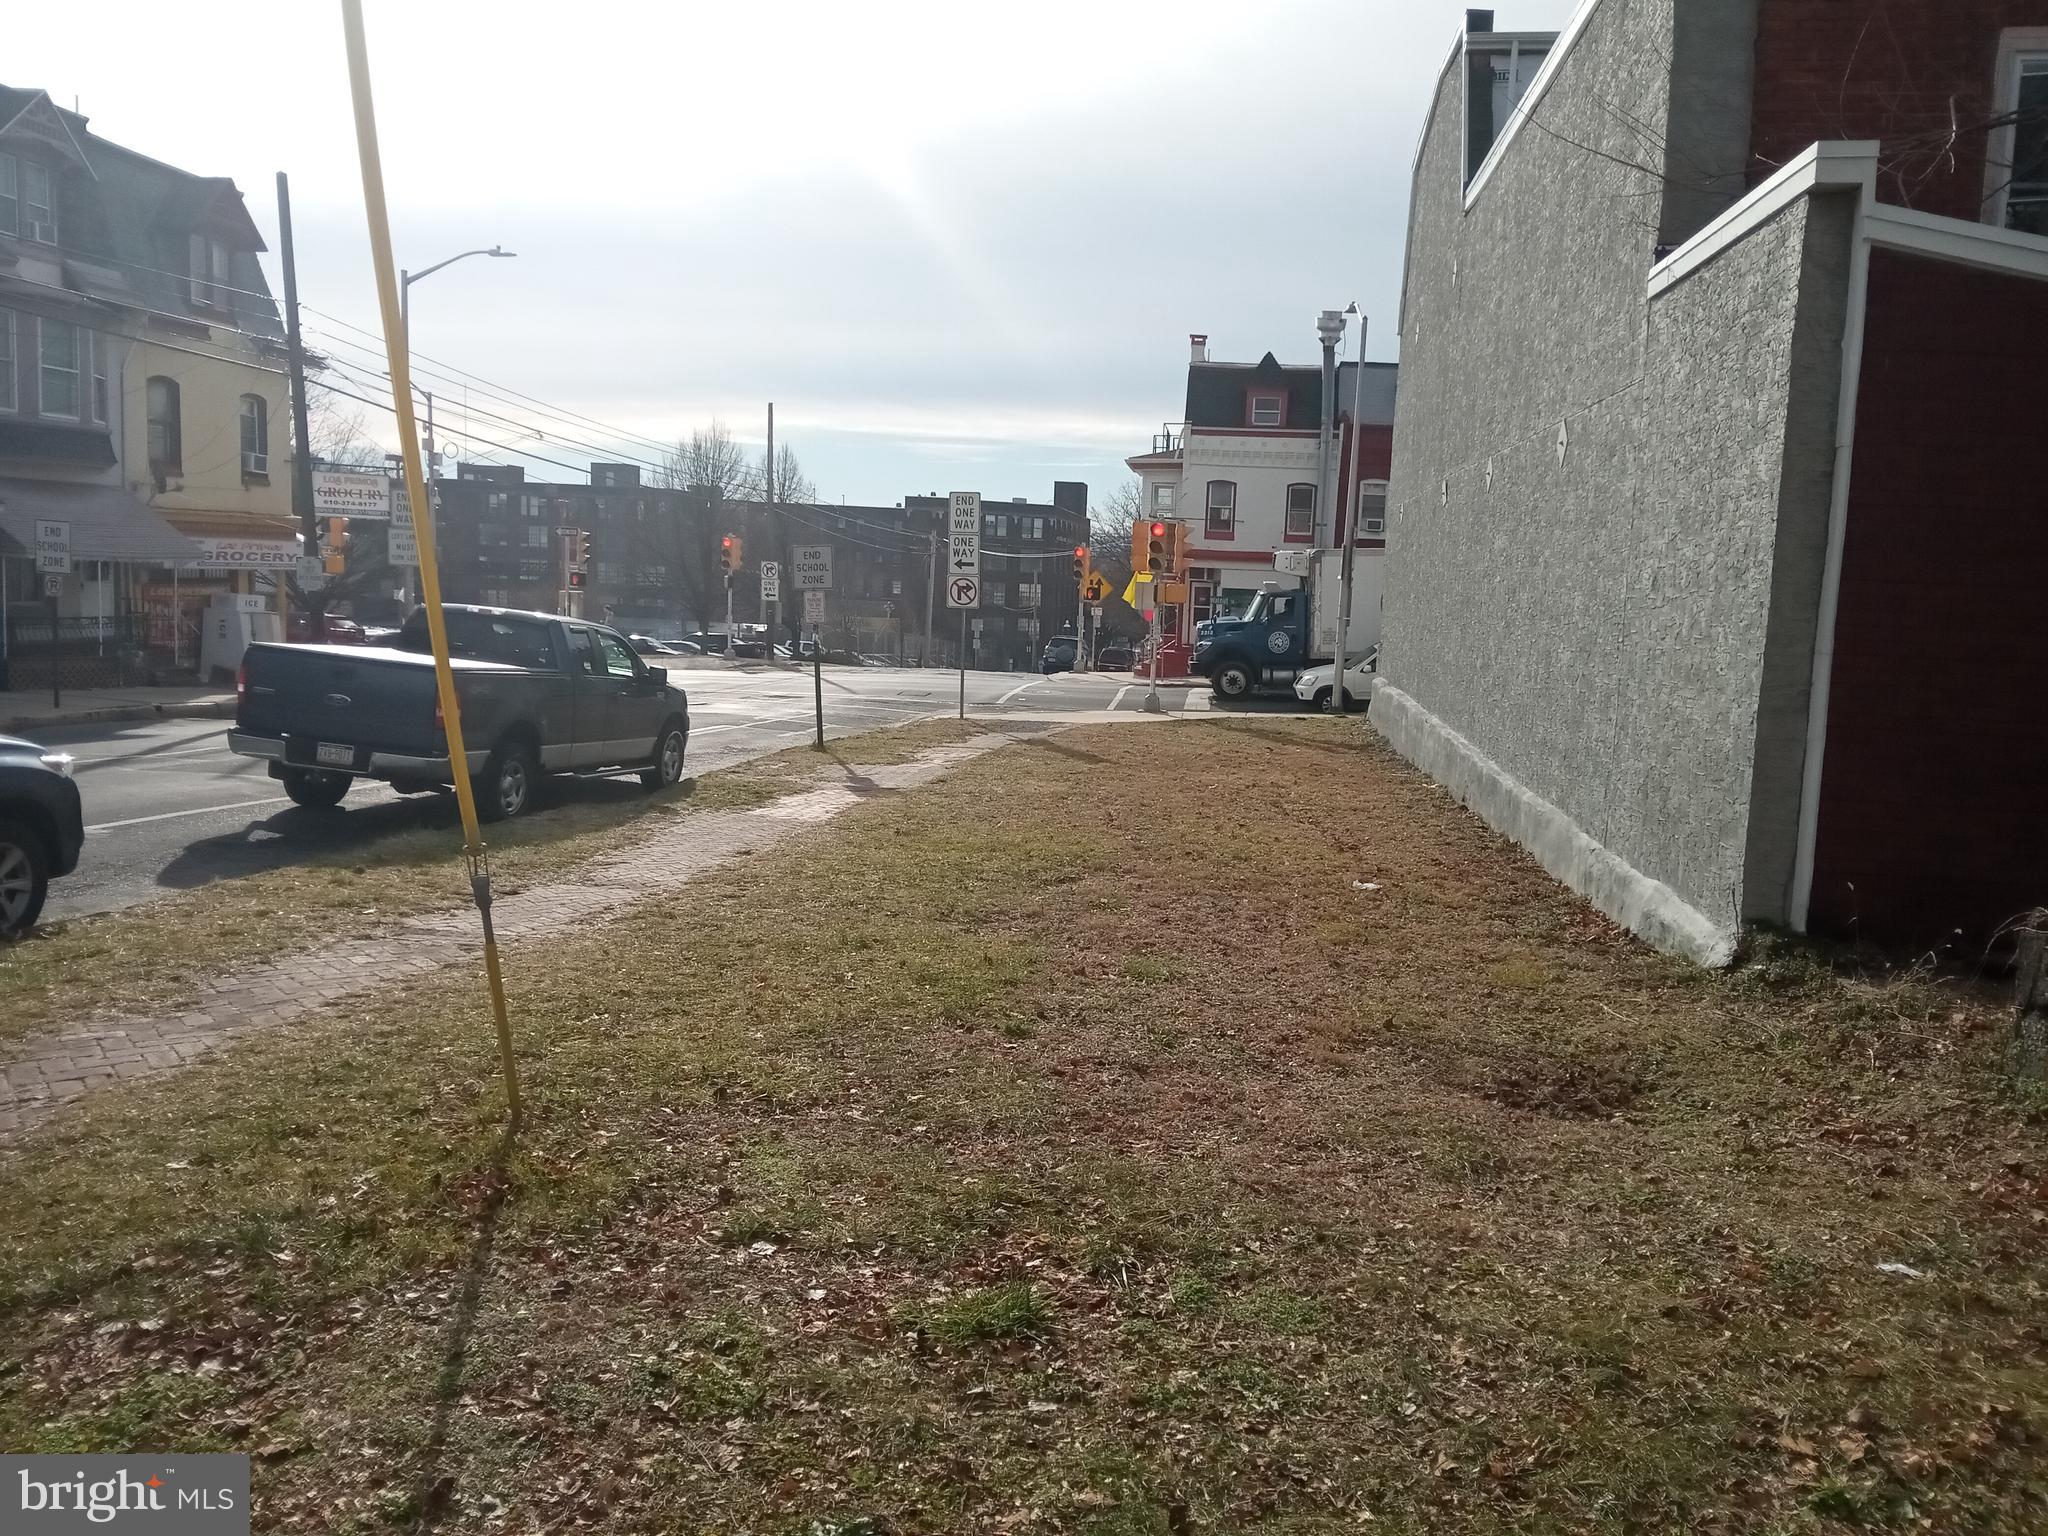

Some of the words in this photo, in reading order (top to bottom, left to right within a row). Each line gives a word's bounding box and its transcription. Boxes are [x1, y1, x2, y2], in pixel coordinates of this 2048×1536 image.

[956, 496, 974, 506] END
[955, 508, 974, 517] ONE
[954, 520, 975, 529] WAY
[44, 526, 61, 537] END
[37, 540, 67, 553] SCHOOL
[953, 537, 974, 547] ONE
[803, 551, 821, 560] END
[953, 548, 975, 558] WAY
[43, 556, 65, 568] ZONE
[796, 563, 829, 573] SCHOOL
[802, 575, 825, 584] ZONE
[244, 600, 260, 608] ICE
